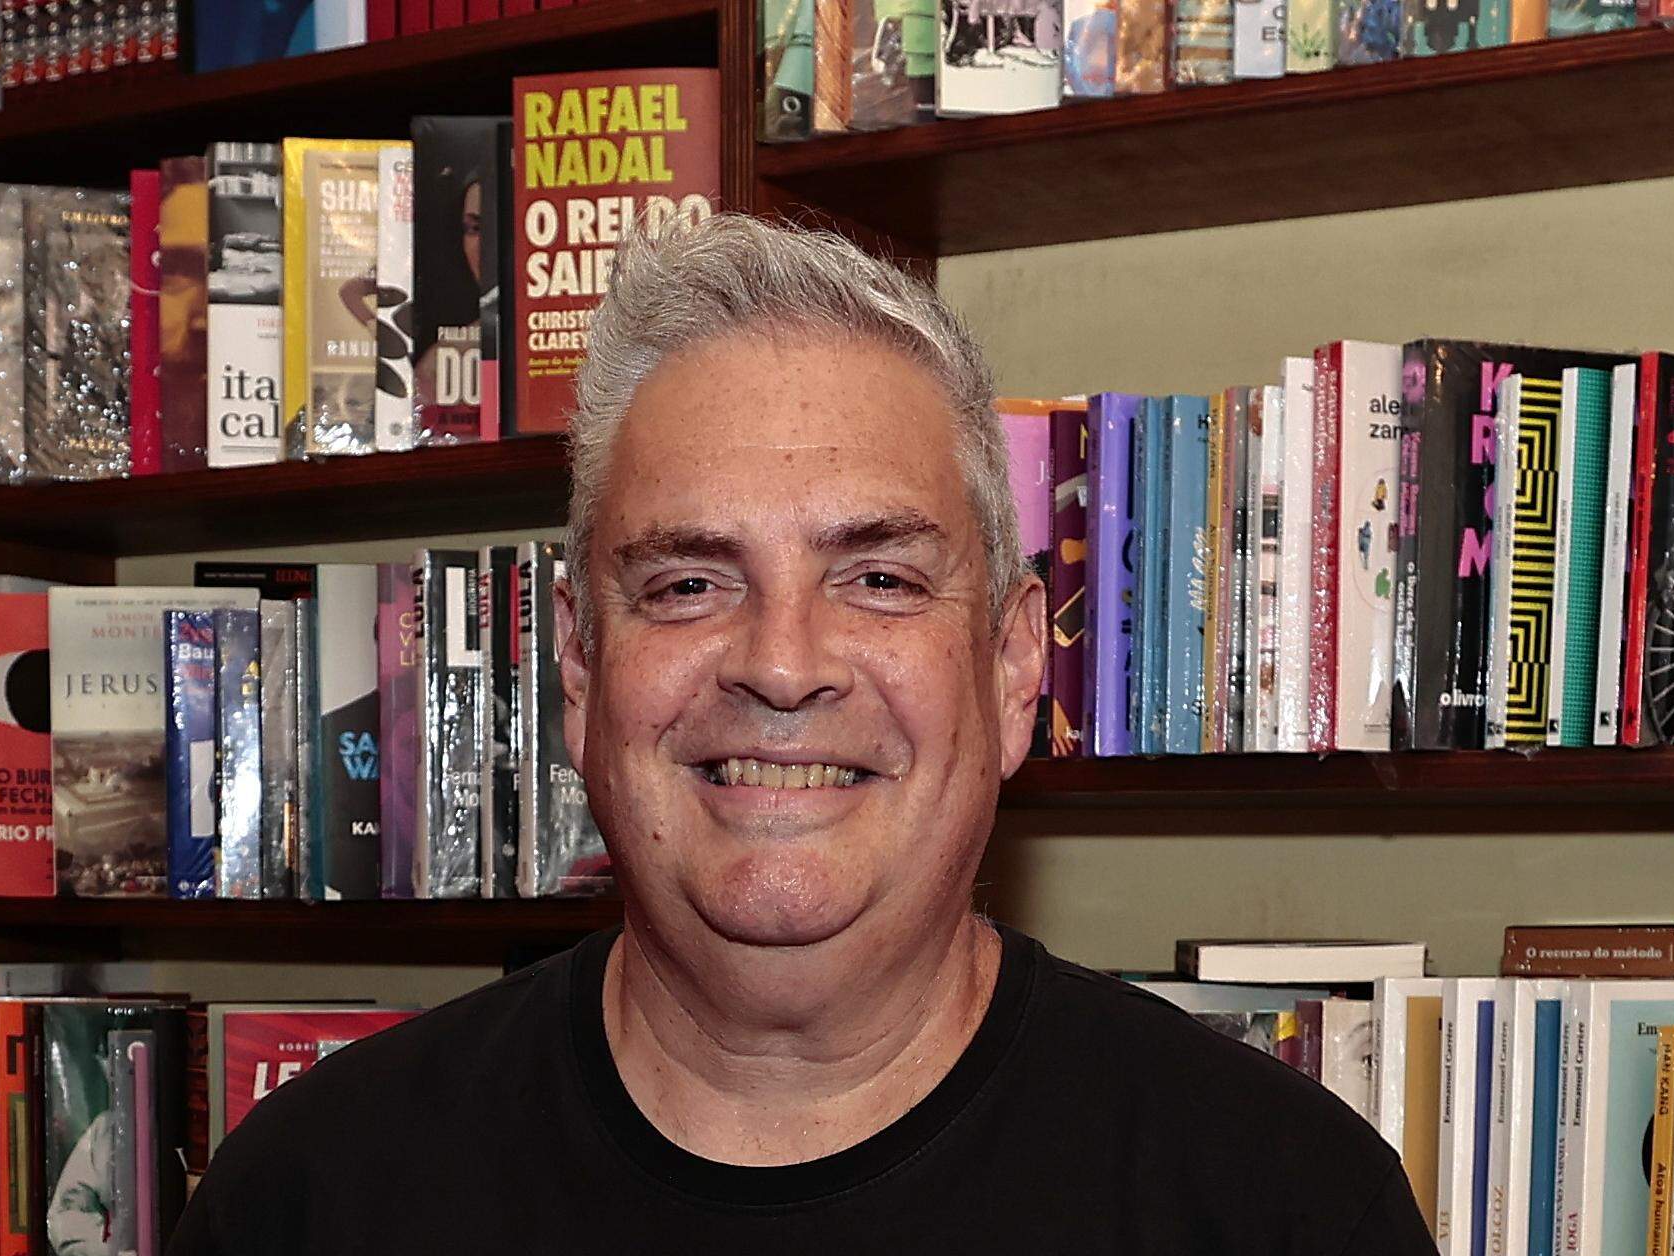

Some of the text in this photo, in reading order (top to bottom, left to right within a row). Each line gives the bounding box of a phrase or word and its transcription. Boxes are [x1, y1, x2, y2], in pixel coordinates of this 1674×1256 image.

[526, 84, 688, 138] RAFAEL
[526, 135, 674, 189] NADAL
[525, 200, 559, 248] O
[567, 197, 635, 245] REI
[221, 362, 282, 402] ita
[221, 403, 282, 441] cal
[520, 560, 532, 634] LULA
[66, 673, 158, 697] JERUS
[15, 768, 52, 786] BUR
[1540, 949, 1589, 959] recurso
[1593, 946, 1610, 959] do
[1613, 946, 1663, 959] método
[1658, 1077, 1670, 1115] KANG
[1567, 1022, 1585, 1251] IOGA Emmanuel Carrère
[1655, 1162, 1667, 1194] Atos
